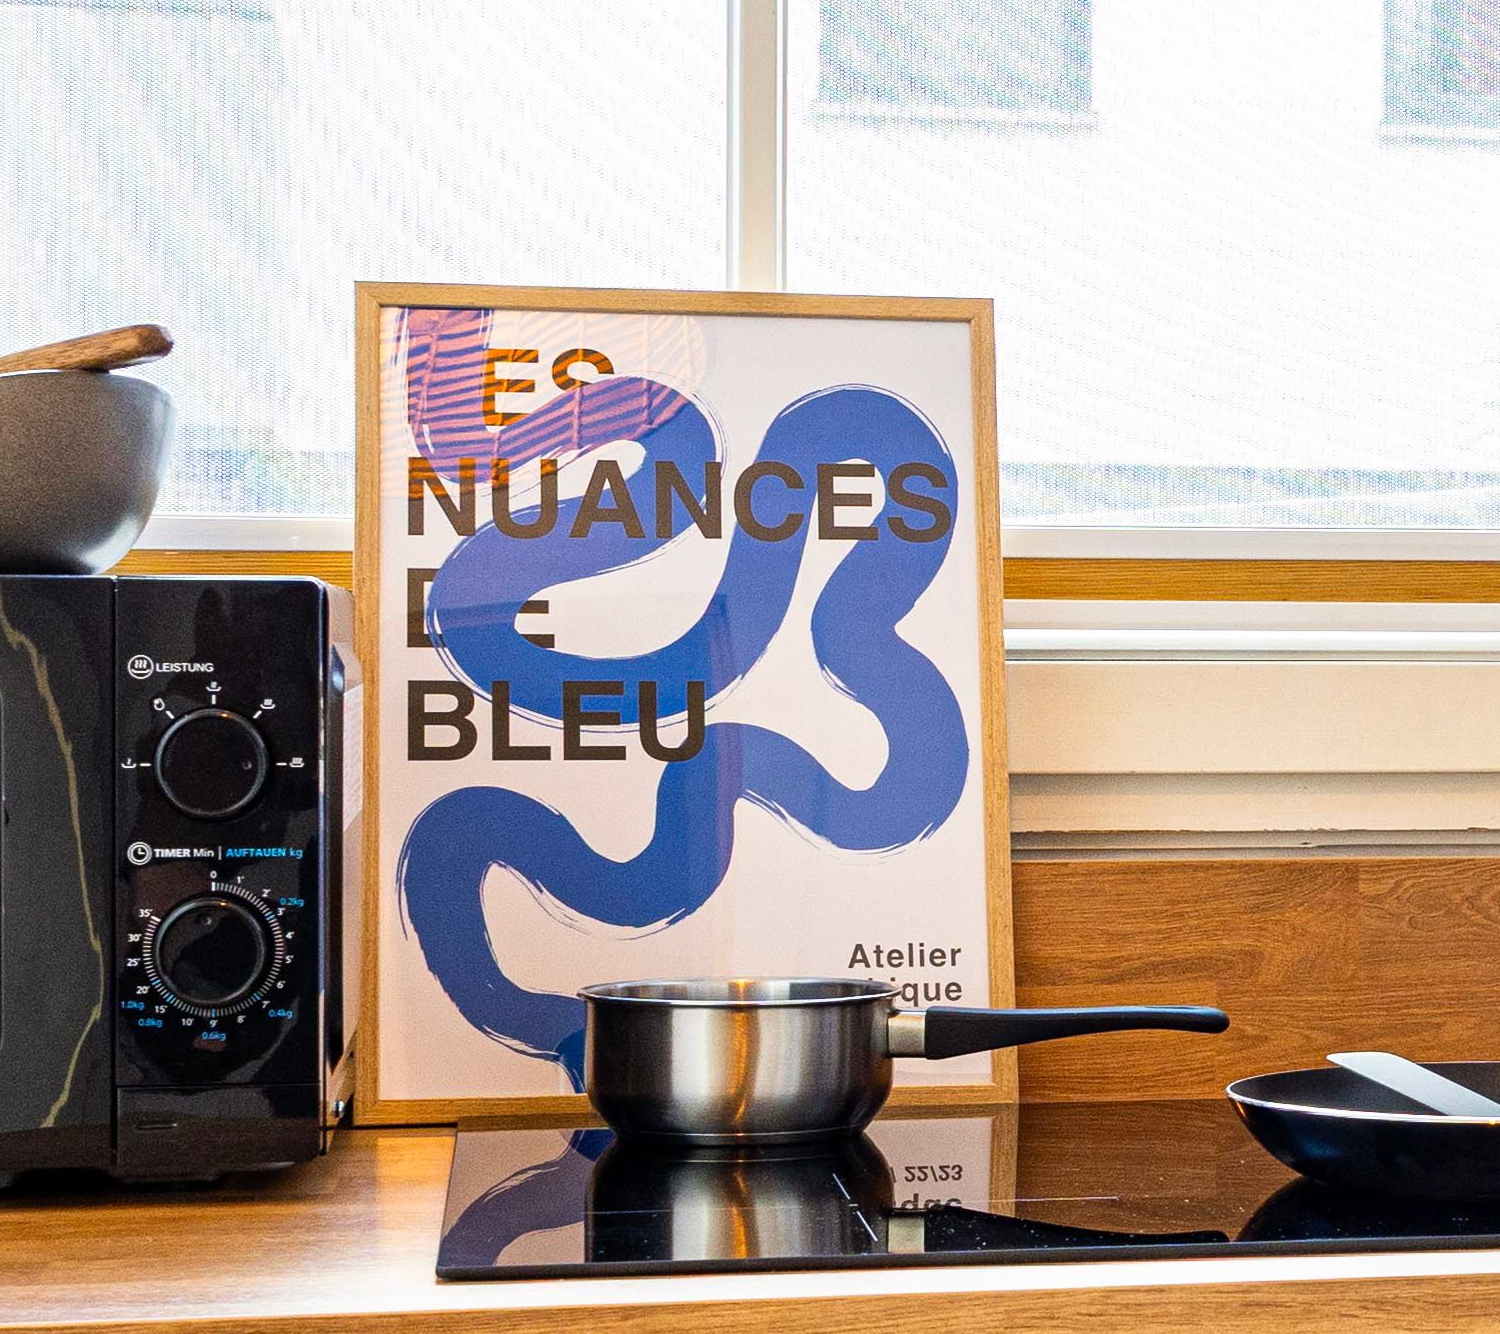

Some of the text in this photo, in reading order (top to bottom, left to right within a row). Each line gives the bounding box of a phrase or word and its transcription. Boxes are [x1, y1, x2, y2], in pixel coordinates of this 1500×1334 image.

[406, 456, 953, 544] NUANCES
[155, 662, 215, 673] LEISTUNG
[406, 679, 707, 762] BLEU
[154, 848, 215, 858] TIMER Min
[225, 847, 303, 860] AUFTAUEN kg
[847, 942, 962, 969] Atelier
